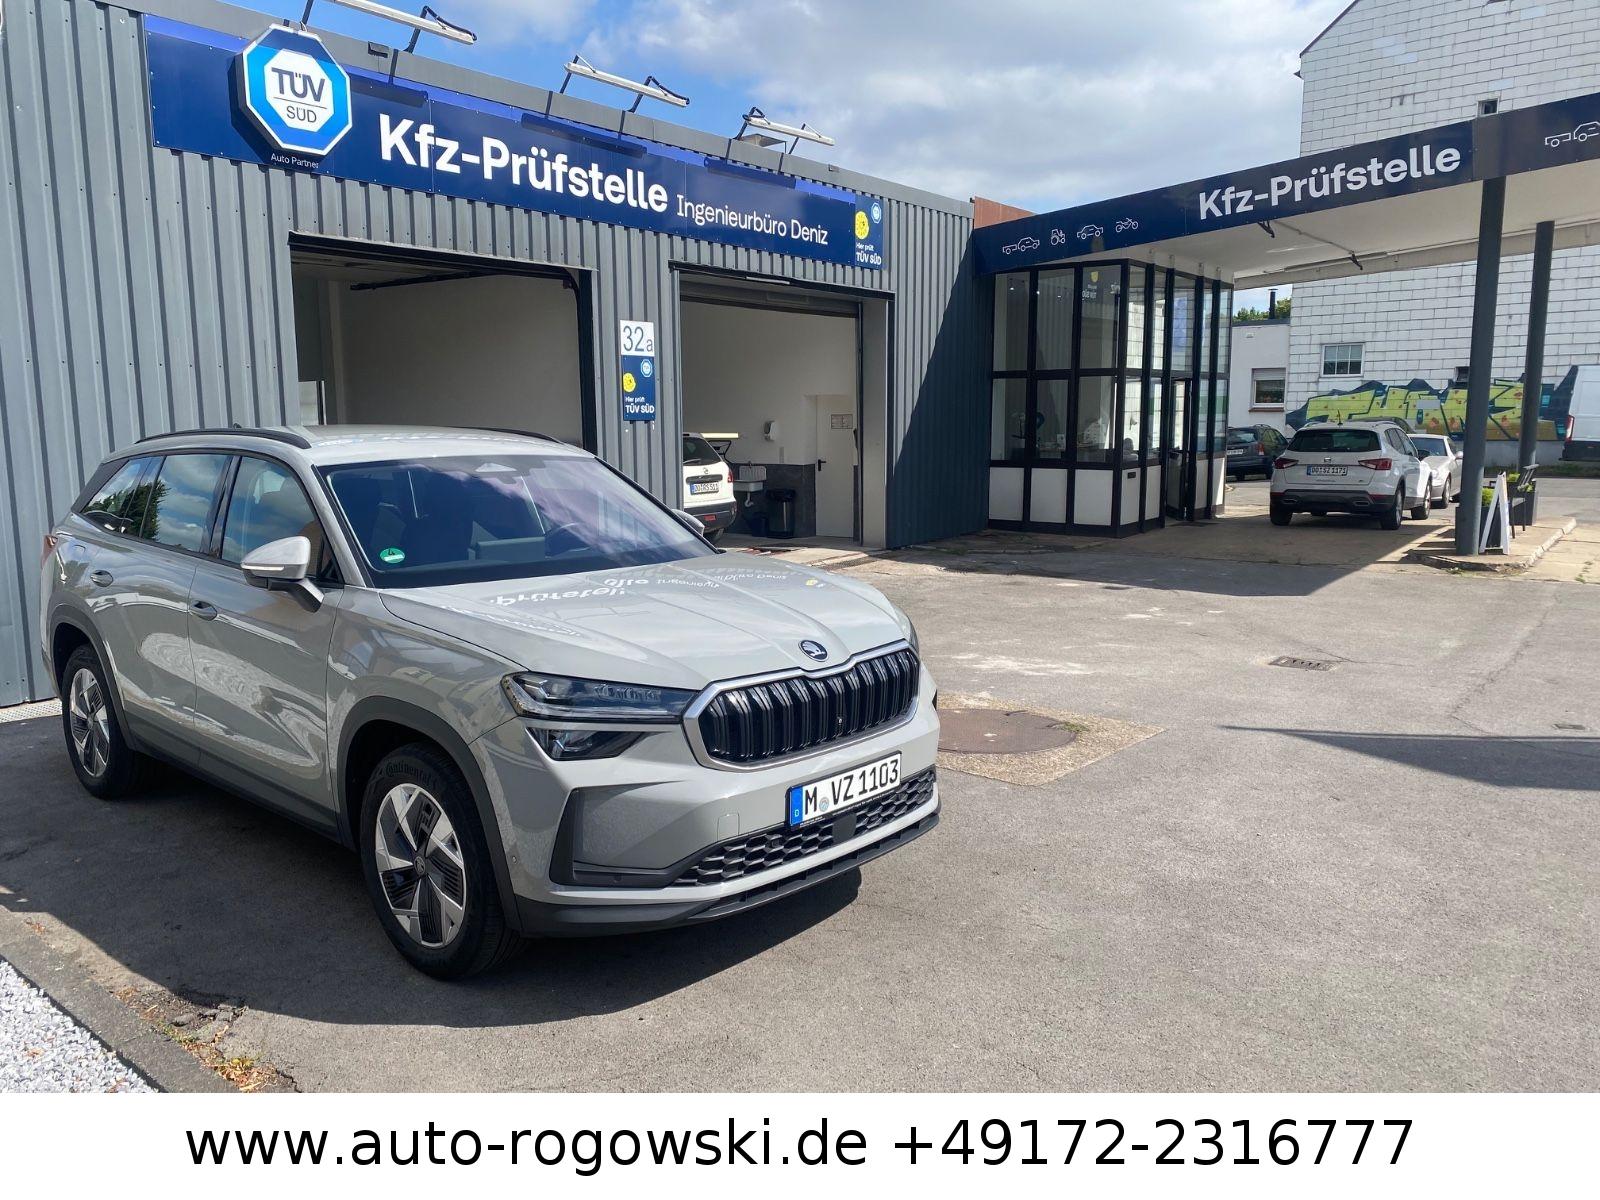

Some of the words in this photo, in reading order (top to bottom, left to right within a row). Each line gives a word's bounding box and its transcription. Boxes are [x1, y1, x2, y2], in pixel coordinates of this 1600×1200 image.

[271, 67, 325, 102] TÜV
[286, 105, 317, 123] SÜD
[270, 153, 290, 164] Auto
[291, 156, 319, 169] Partner
[379, 113, 668, 213] Kfz-Prüfstelle
[1200, 146, 1461, 220] Kfz-Prüfstelle
[676, 194, 787, 237] Ingenieurbüro
[791, 219, 828, 245] Deniz
[856, 250, 869, 263] TÜV
[869, 253, 882, 265] SÜD
[623, 325, 653, 352] 32a
[625, 403, 640, 413] TÜV
[641, 403, 654, 413] SÜD
[805, 786, 817, 815] M
[831, 774, 853, 805] VZ
[858, 759, 899, 795] 1103
[794, 809, 800, 817] D
